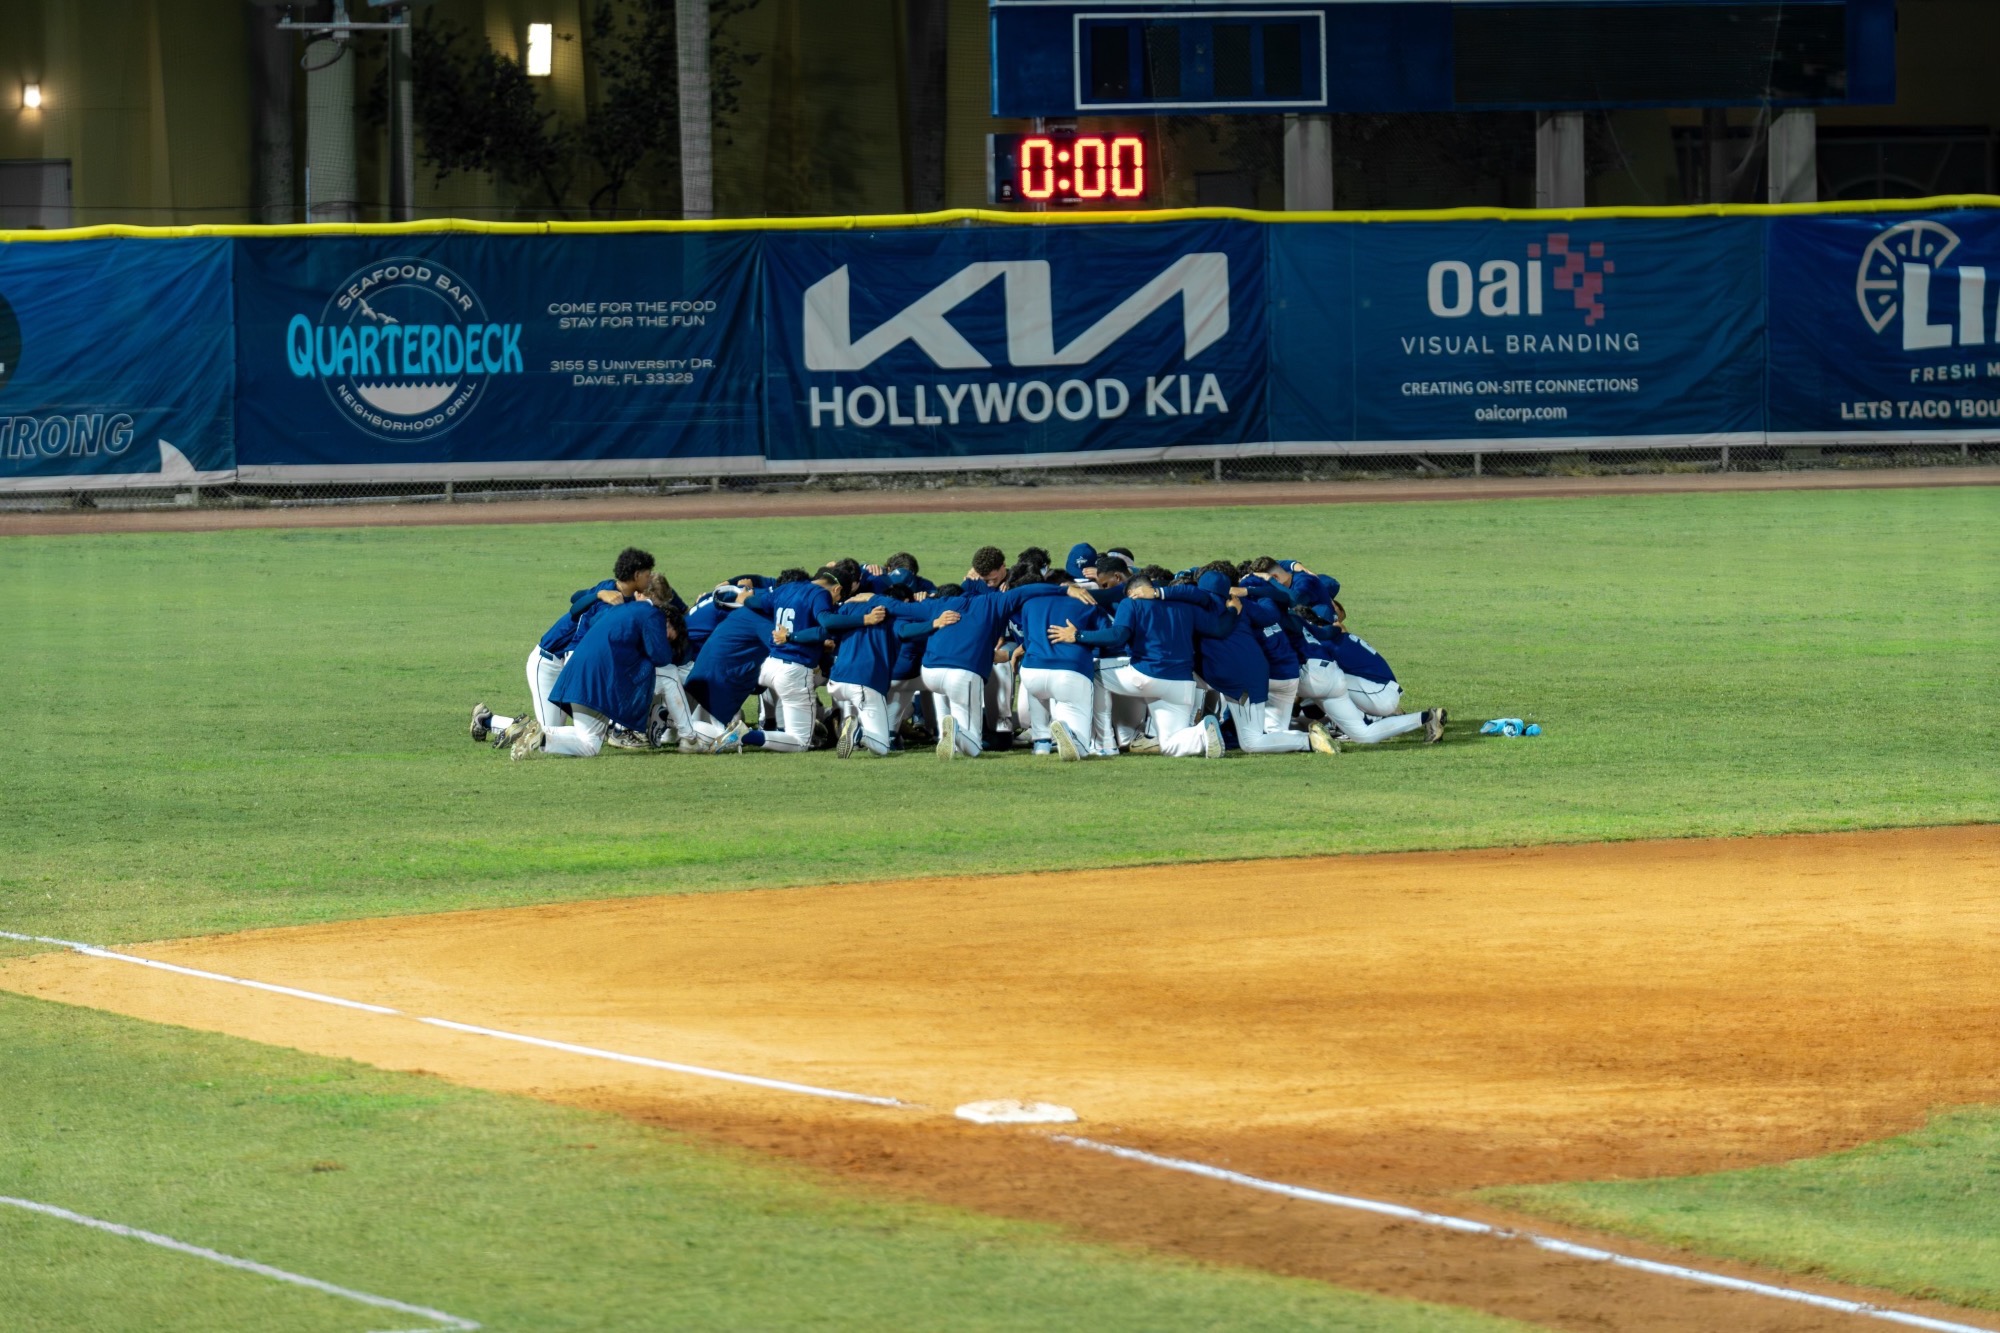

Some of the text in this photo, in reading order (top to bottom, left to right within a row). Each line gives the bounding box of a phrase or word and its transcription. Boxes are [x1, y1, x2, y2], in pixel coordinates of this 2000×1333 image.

[1022, 138, 1143, 197] 0:00
[337, 265, 473, 312] SEAFOOD BAR
[1427, 243, 1543, 318] oai
[548, 300, 716, 315] COME FOR THE FOOD
[804, 252, 1230, 371] KIA
[559, 315, 705, 329] STAY FOR THE FUN
[287, 314, 523, 379] QUARTERDECK
[1401, 333, 1640, 354] VISUAL BRANDING
[550, 360, 584, 371] 3155
[588, 359, 598, 370] S
[602, 359, 686, 370] UNIVERSITY
[1910, 363, 1976, 384] FRESH
[573, 373, 694, 386] DAVIE, FL 33328
[1402, 378, 1639, 396] CREATING ON-SITE CONNECTIONS
[337, 382, 477, 431] NEIGHBORHOOD GRILL
[810, 373, 1229, 427] HOLLYWOOD KIA
[1841, 400, 1893, 419] LETS
[1897, 400, 1951, 418] TACO
[1475, 404, 1567, 423] oaicorp.com
